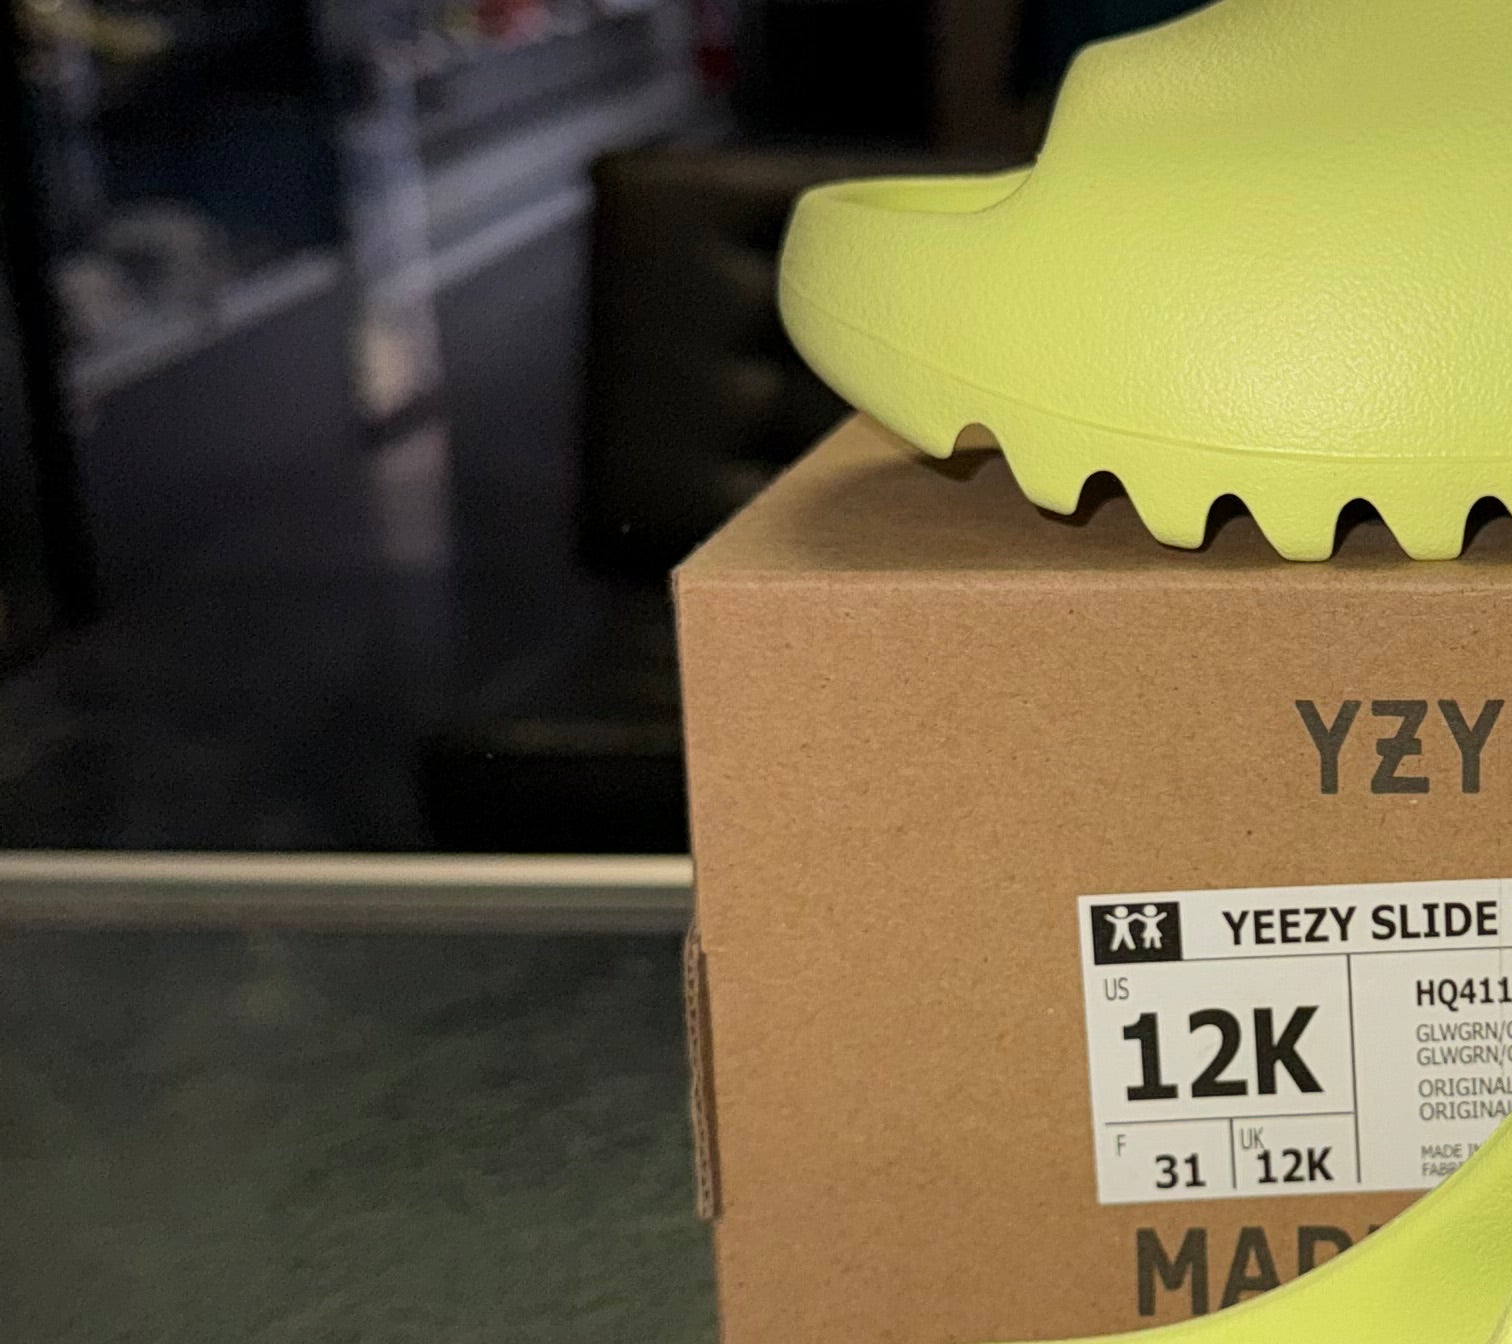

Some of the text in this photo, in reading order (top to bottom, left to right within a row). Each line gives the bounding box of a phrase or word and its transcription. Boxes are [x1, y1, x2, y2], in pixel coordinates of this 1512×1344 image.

[1295, 699, 1505, 794] YZY
[1222, 905, 1357, 946] YEEZY
[1371, 900, 1498, 940] SLIDE
[1104, 976, 1130, 1001] US
[1122, 1005, 1325, 1102] 12K
[1116, 1133, 1126, 1157] F
[1240, 1127, 1264, 1150] UK
[1421, 1143, 1463, 1159] MADE
[1155, 1152, 1207, 1190] 31
[1256, 1146, 1335, 1184] 12K
